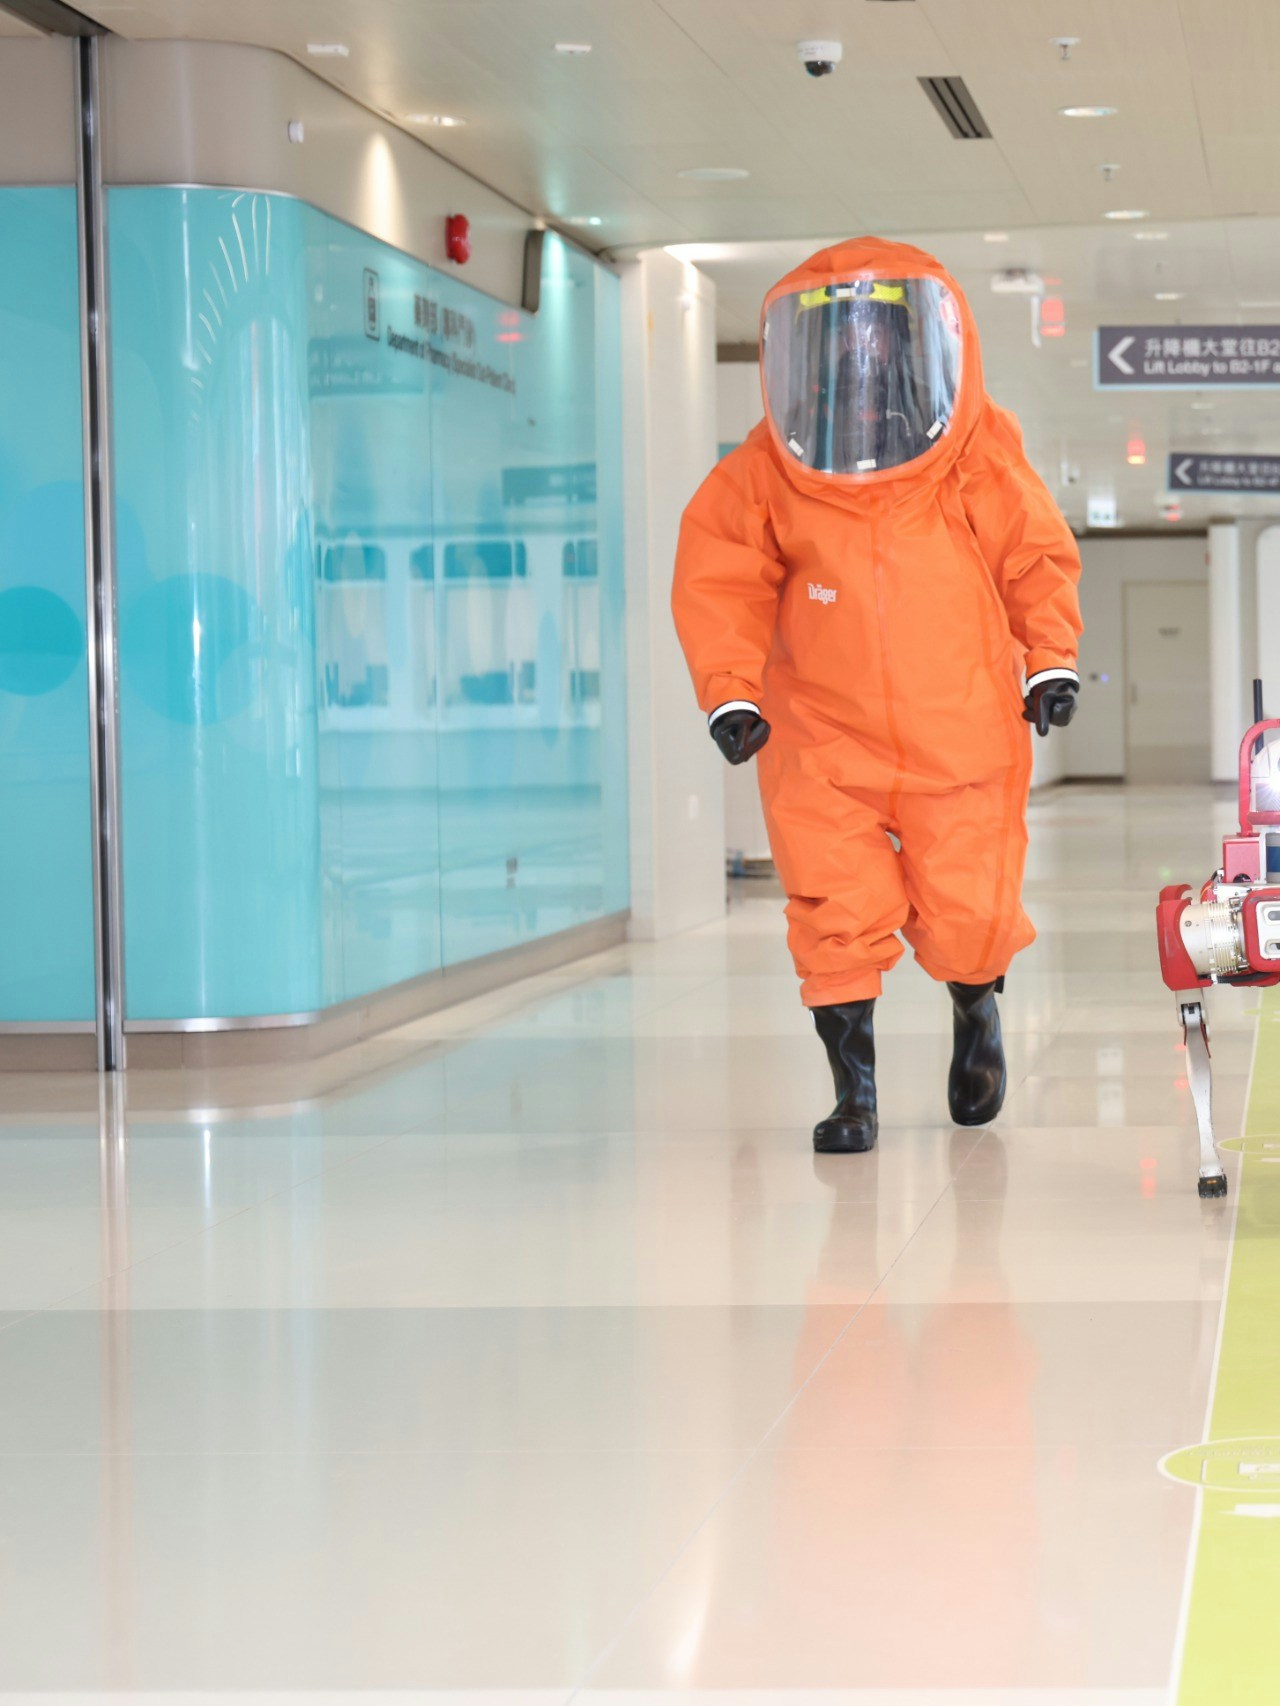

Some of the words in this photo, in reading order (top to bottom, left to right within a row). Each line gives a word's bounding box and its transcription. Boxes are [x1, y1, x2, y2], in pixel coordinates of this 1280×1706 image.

[1143, 359, 1166, 375] Lift
[1167, 359, 1210, 378] Lobby
[1212, 360, 1229, 375] to
[1229, 359, 1271, 375] B2-1F
